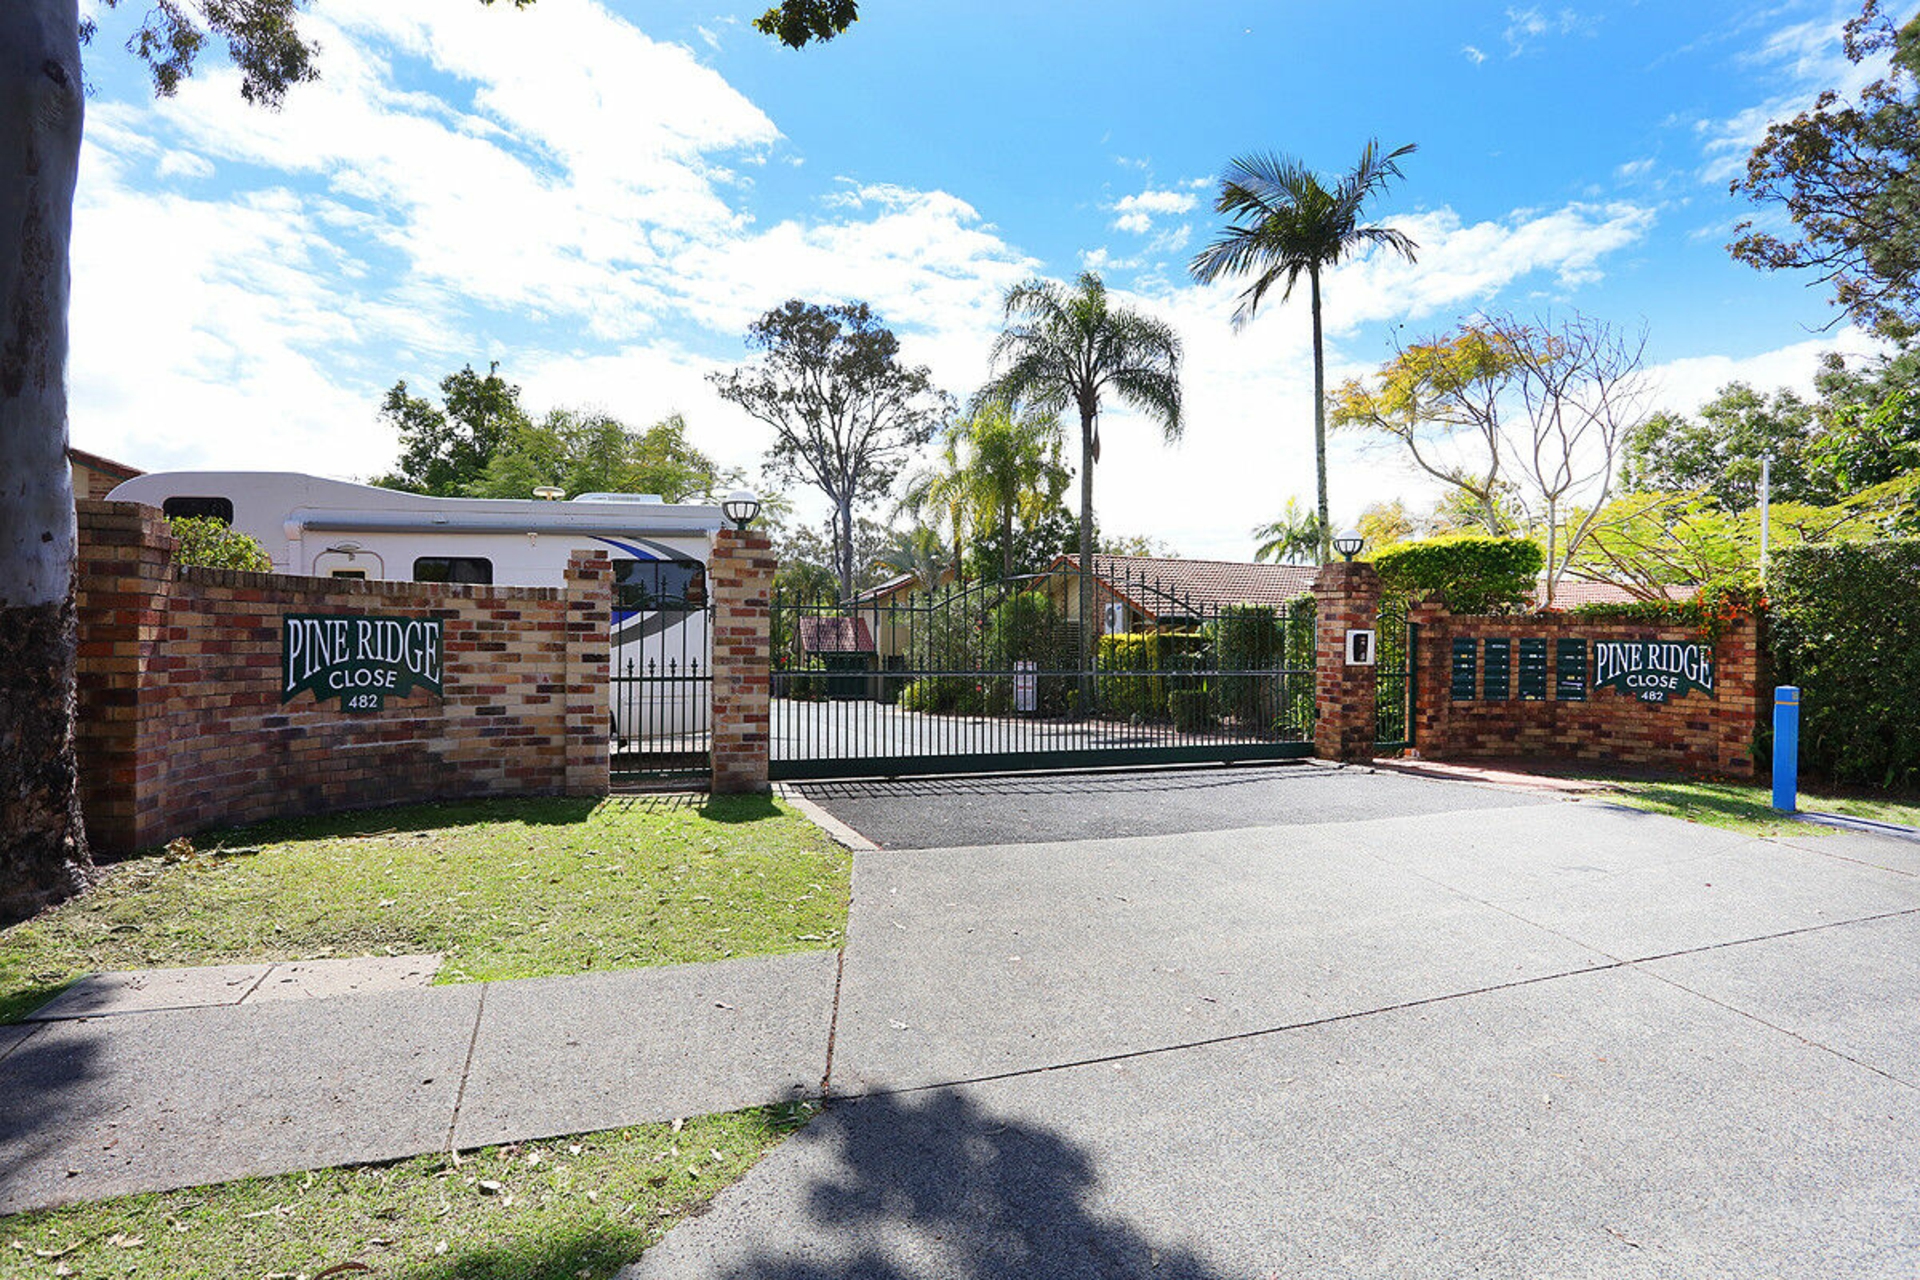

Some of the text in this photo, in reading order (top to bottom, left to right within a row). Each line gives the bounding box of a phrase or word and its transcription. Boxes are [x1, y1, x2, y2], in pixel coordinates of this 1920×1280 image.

[286, 618, 440, 692] PINE RIDGE
[1595, 643, 1643, 686] PINE
[1647, 644, 1713, 690] RIDGE
[328, 668, 398, 689] CLOSE
[1626, 674, 1679, 690] CLOSE
[348, 693, 378, 708] 482
[1641, 690, 1664, 701] 482
